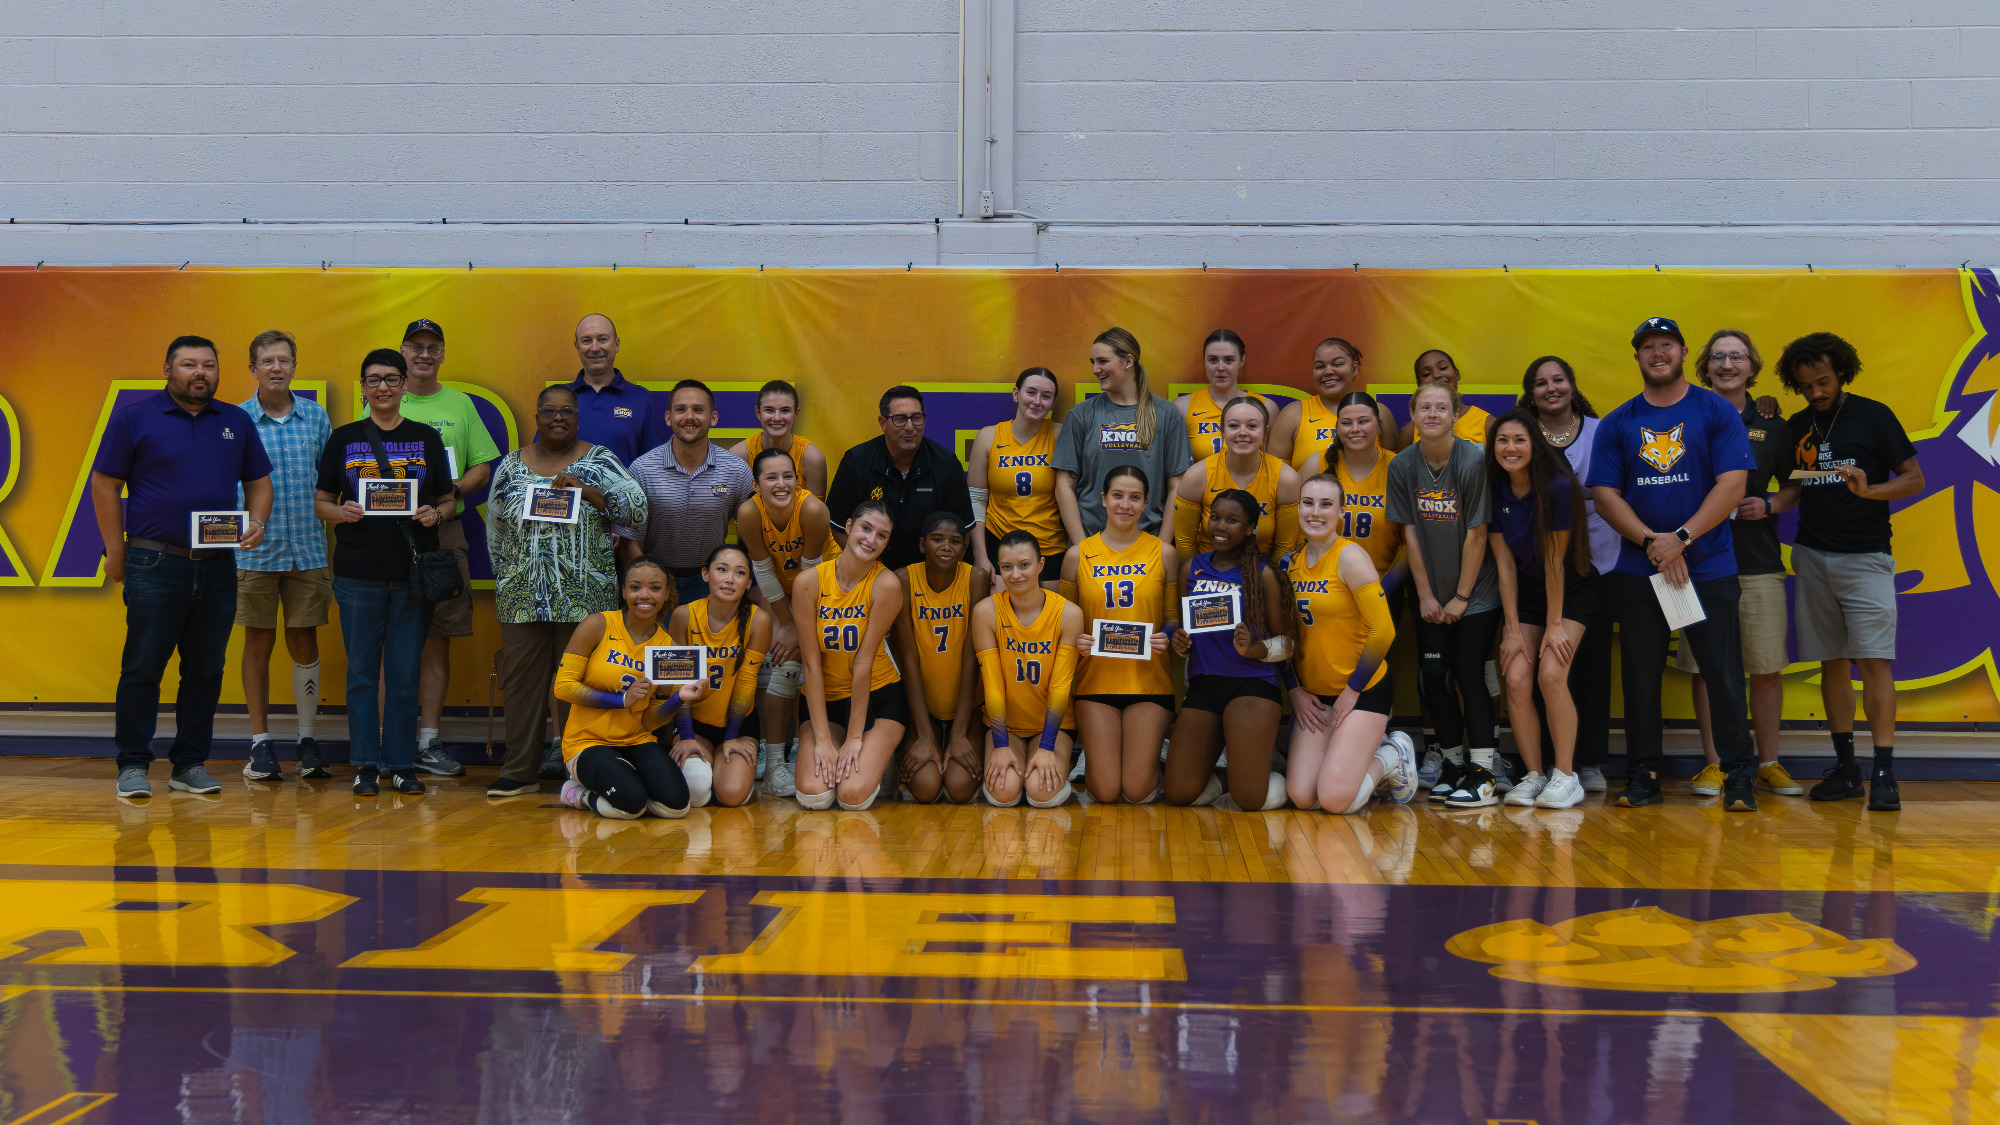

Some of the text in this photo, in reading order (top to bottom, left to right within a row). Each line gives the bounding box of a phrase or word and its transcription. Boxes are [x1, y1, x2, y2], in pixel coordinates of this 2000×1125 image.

[1101, 430, 1137, 443] KNO
[1197, 422, 1221, 435] KN
[382, 441, 425, 454] OLLEGE
[1818, 451, 1833, 461] RISE
[997, 453, 1050, 469] KNOX
[1014, 471, 1033, 497] 8
[1637, 472, 1690, 486] BASEBALL
[1813, 474, 1846, 485] STRO
[1345, 494, 1385, 509] NOX
[1417, 497, 1458, 514] KNOX
[1342, 511, 1373, 539] 18
[1092, 563, 1148, 578] KNOX
[1103, 580, 1135, 609] 13
[819, 604, 867, 620] KNOX
[918, 603, 965, 621] KNOX
[1296, 598, 1315, 626] 5
[823, 623, 860, 652] 20
[933, 625, 950, 653] 7
[1005, 636, 1052, 655] KNOX
[706, 644, 741, 659] NOX
[606, 648, 645, 673] KNO
[708, 664, 725, 691] 2
[1016, 657, 1042, 686] 10
